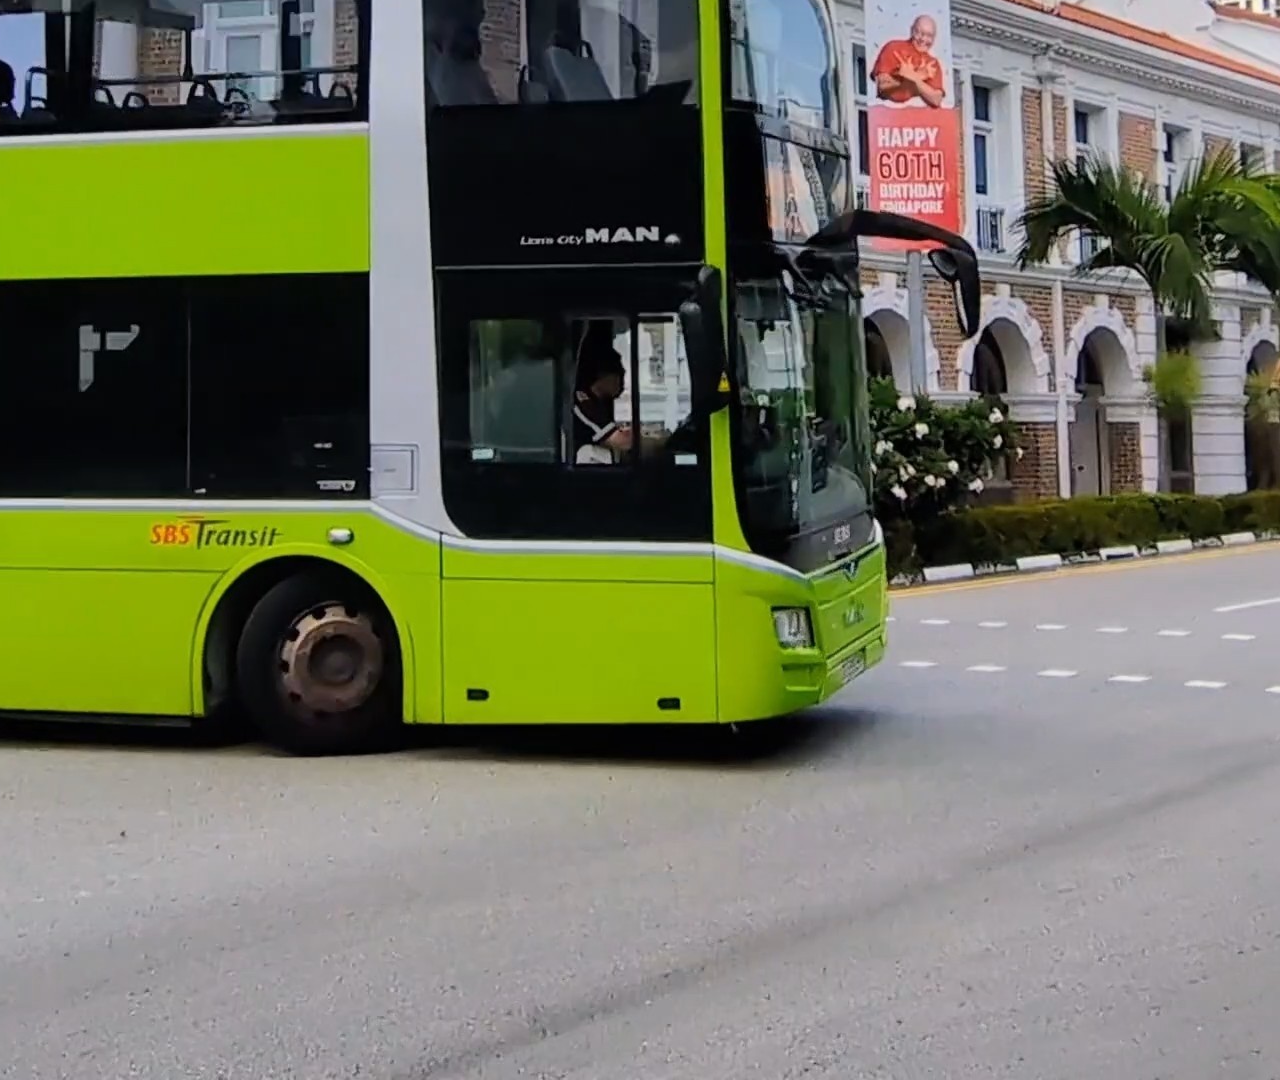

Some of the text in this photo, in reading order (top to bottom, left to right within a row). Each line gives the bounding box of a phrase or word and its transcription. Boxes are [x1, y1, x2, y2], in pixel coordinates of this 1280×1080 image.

[877, 127, 939, 148] HAPPY
[877, 150, 945, 181] 60TH
[879, 181, 945, 199] BIRTHDAY
[557, 234, 584, 245] City
[585, 226, 660, 244] MAN
[150, 519, 284, 550] SBS Transit
